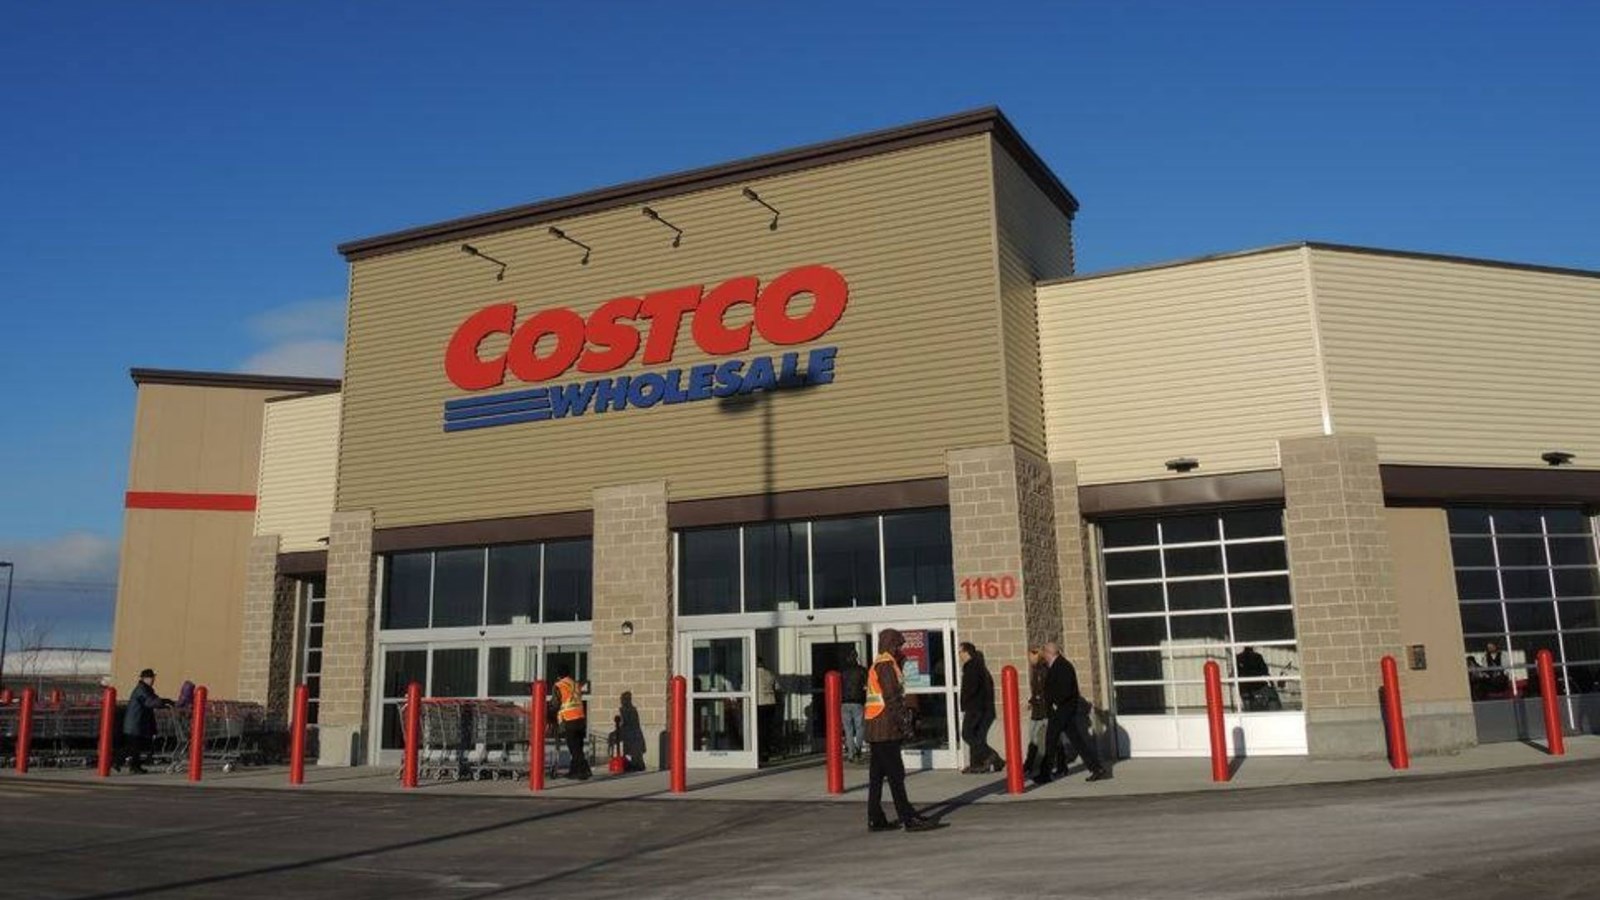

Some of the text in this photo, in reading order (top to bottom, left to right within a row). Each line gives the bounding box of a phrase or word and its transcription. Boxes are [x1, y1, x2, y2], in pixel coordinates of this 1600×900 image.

[444, 264, 849, 390] COSTCO
[548, 346, 838, 419] WHOLESALE
[961, 574, 1017, 600] 1160
